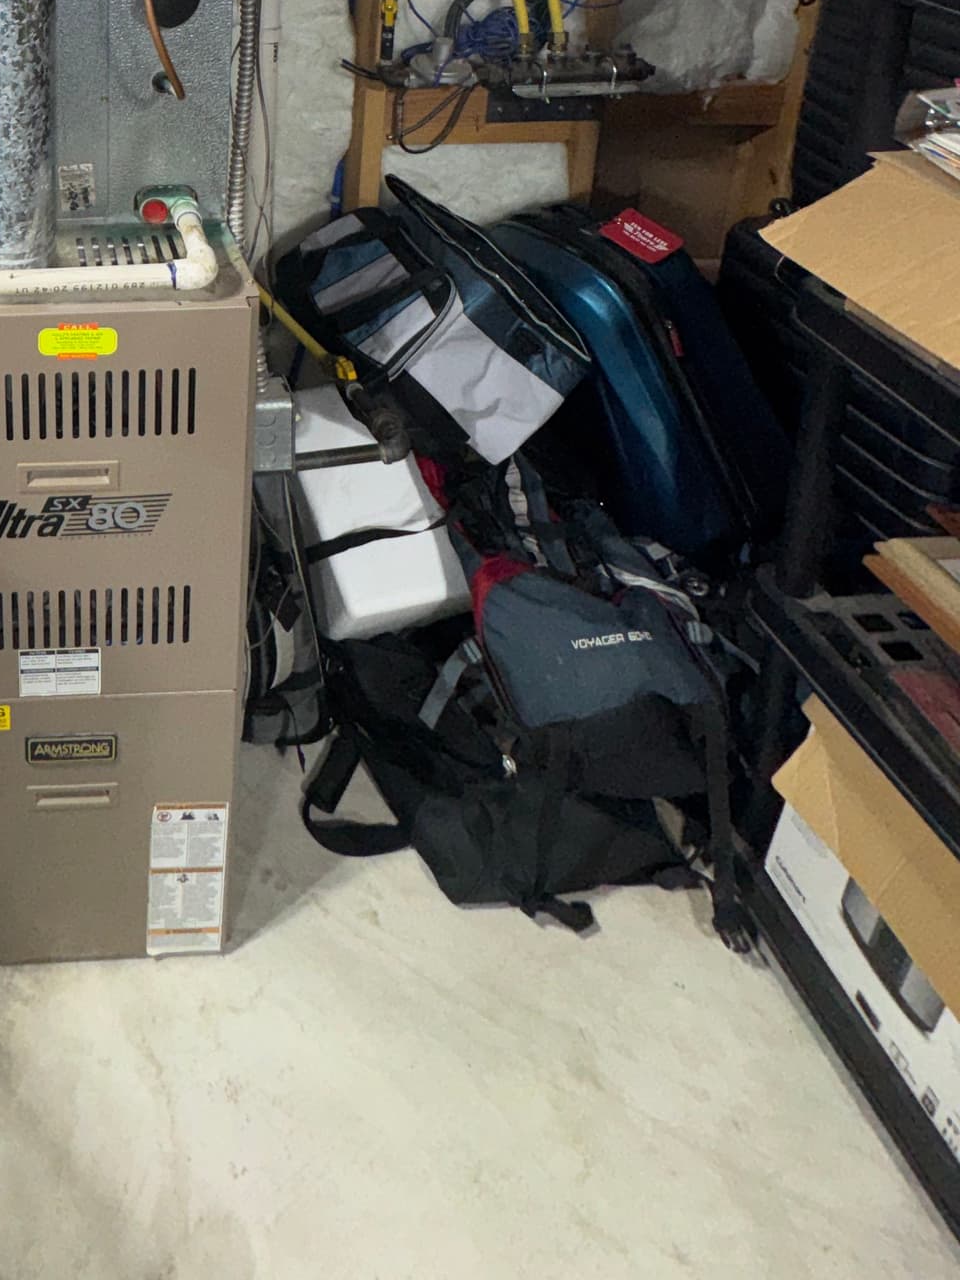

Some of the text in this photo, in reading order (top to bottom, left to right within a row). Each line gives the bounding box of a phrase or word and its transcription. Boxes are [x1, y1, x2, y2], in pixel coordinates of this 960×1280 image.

[50, 498, 82, 511] SX
[88, 502, 147, 531] 80
[571, 633, 625, 649] VOYAGER
[35, 742, 110, 757] ARMSTRONG
